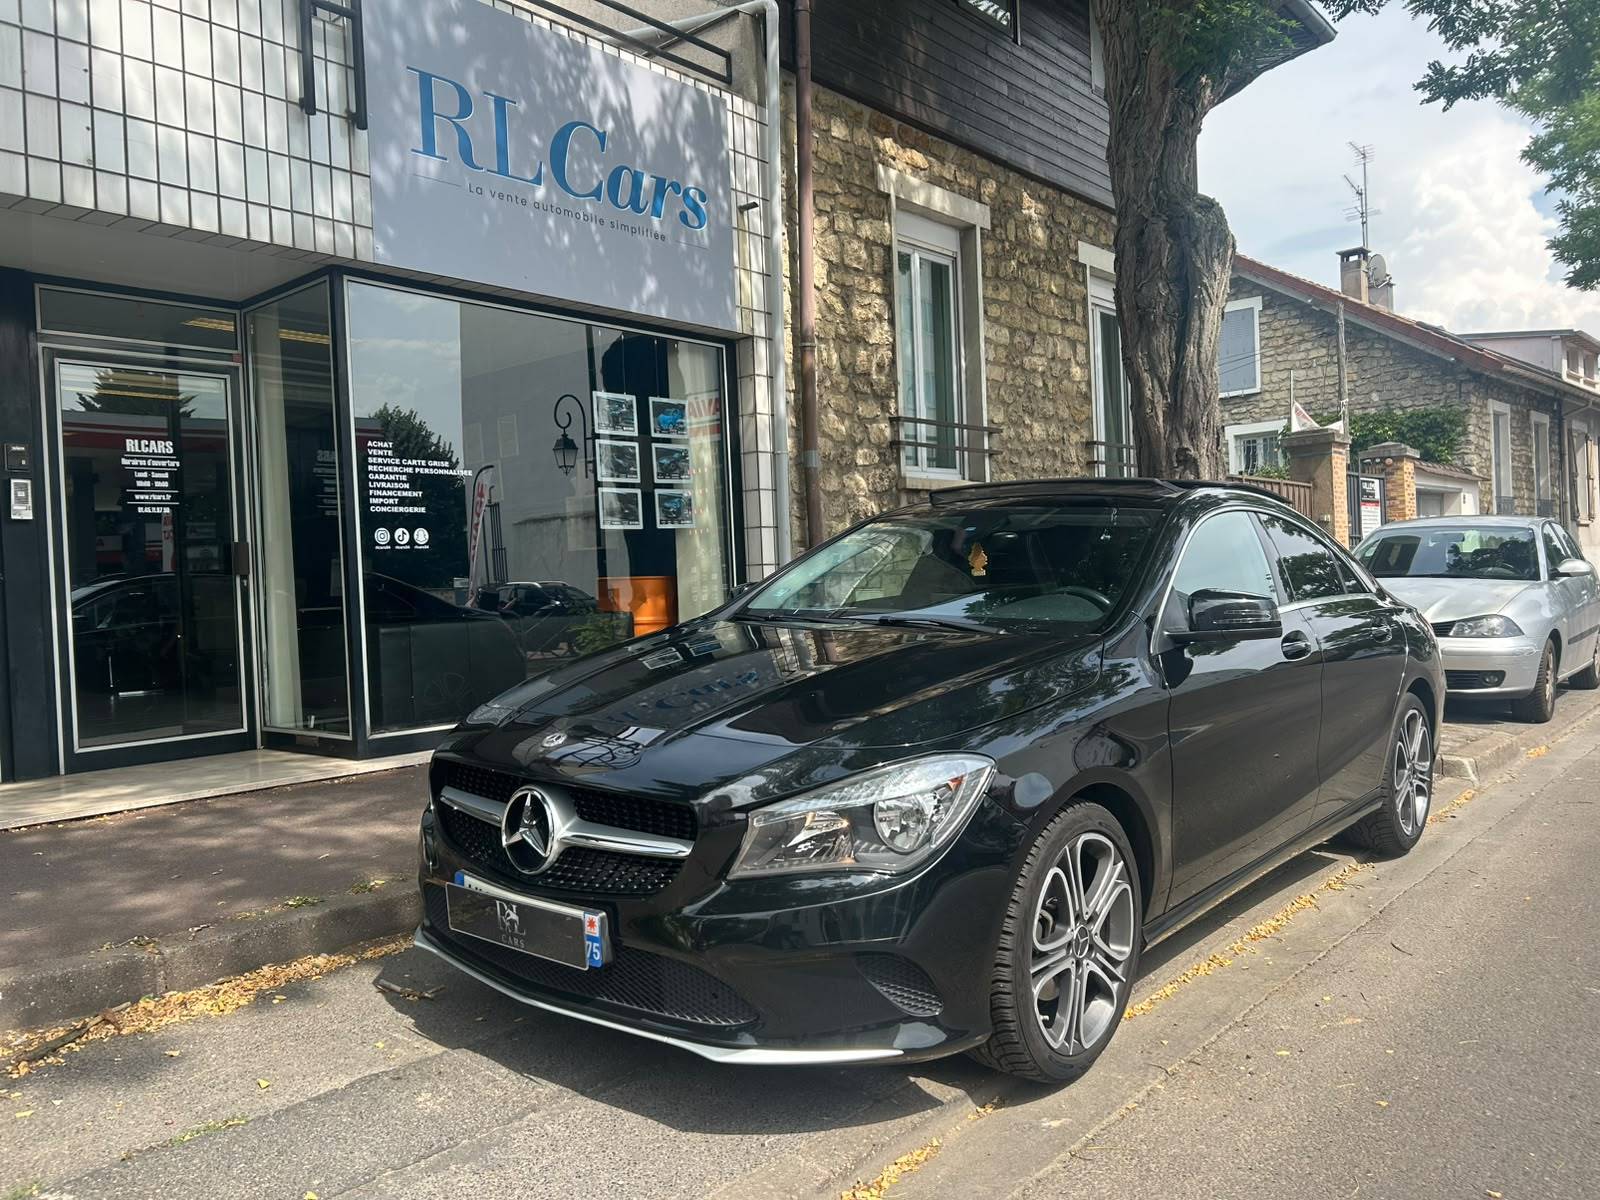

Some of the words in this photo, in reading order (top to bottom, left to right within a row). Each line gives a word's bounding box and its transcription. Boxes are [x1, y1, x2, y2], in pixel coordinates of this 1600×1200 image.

[468, 183, 483, 196] La
[489, 189, 528, 207] vente
[533, 200, 605, 227] automobile
[609, 219, 667, 243] simplifiée
[126, 439, 174, 454] RLCARS
[367, 440, 393, 448] ACHAT
[367, 448, 393, 456] VENTE
[367, 457, 401, 465] SERVICE
[402, 458, 427, 466] CARTE
[368, 465, 414, 473] RECHERCHE
[368, 481, 410, 489] LIVRAISON
[369, 489, 423, 497] FINANCEMENT
[370, 505, 427, 513] CONCIERGERIE
[502, 934, 525, 949] CARS
[585, 941, 600, 960] 75
